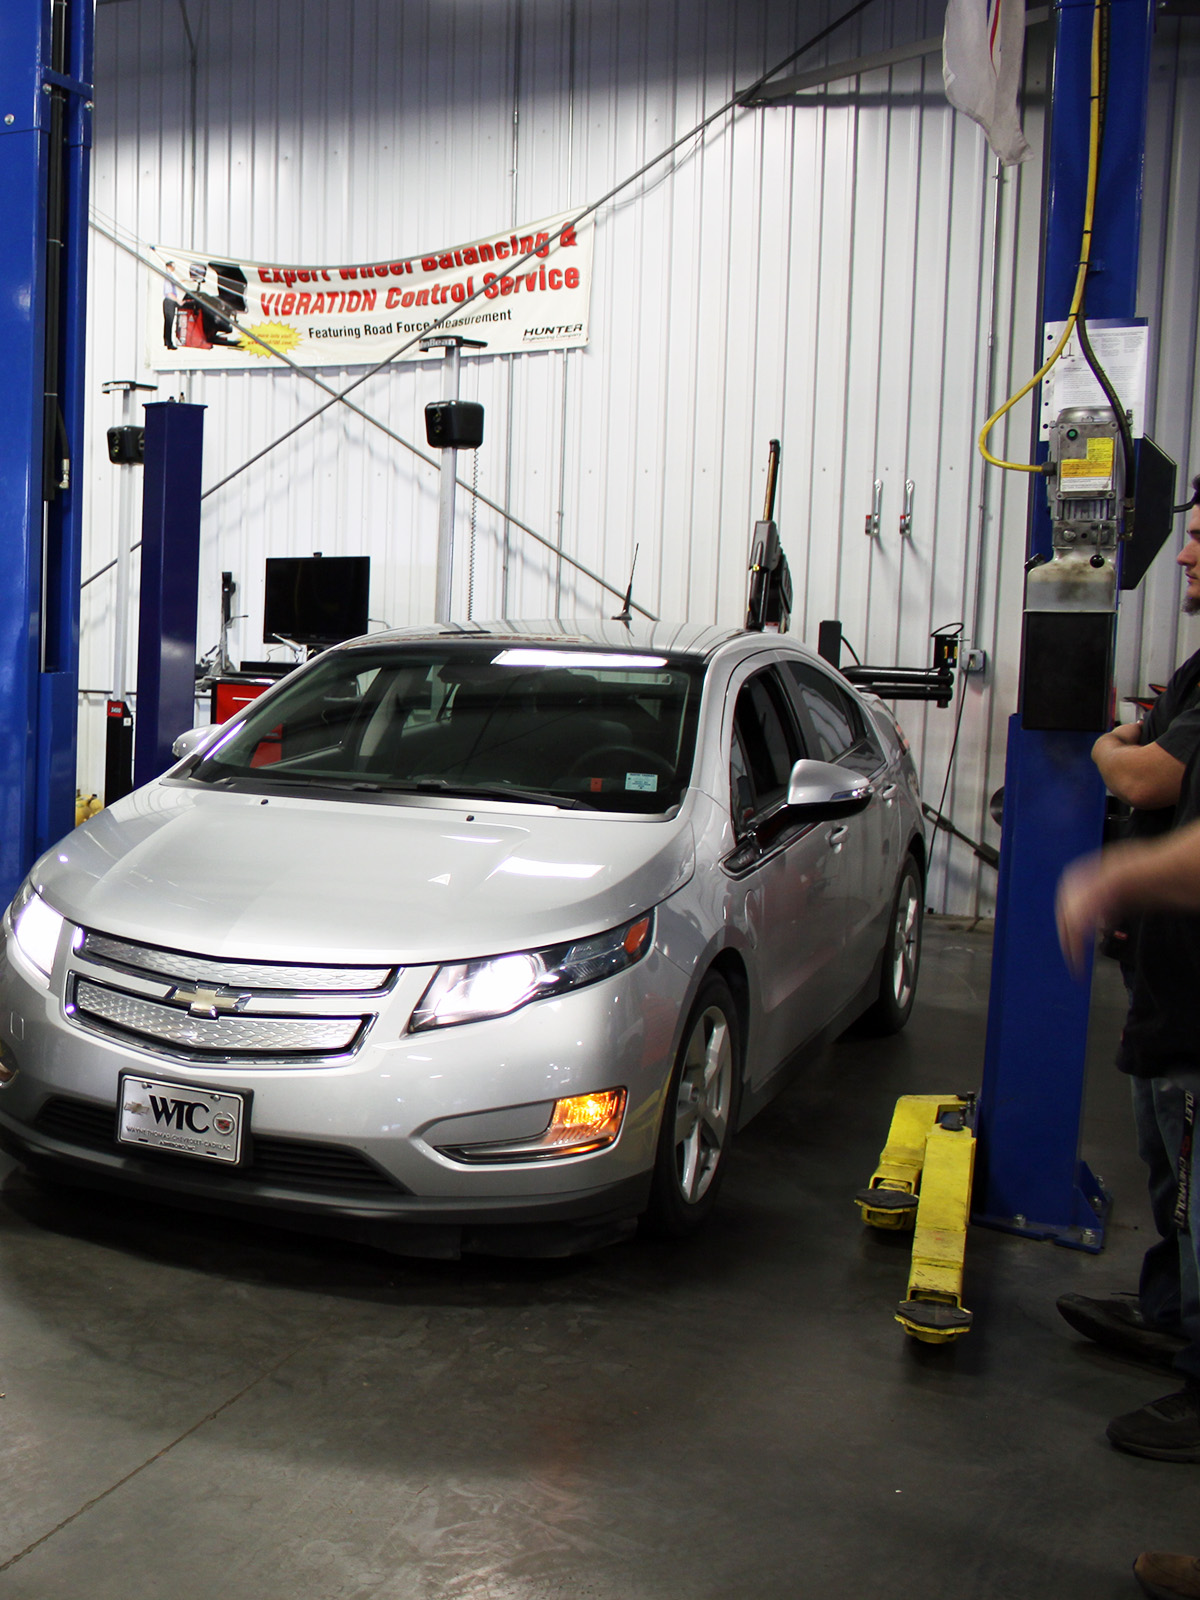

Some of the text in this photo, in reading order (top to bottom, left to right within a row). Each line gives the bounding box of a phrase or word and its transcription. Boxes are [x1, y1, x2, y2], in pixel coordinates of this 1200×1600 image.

[422, 231, 550, 272] Balancing
[260, 264, 580, 317] VIBRATION Control Service
[308, 308, 513, 339] Featuring Road Force Measurement
[523, 323, 584, 337] HUNTER
[148, 1094, 210, 1134] WTC
